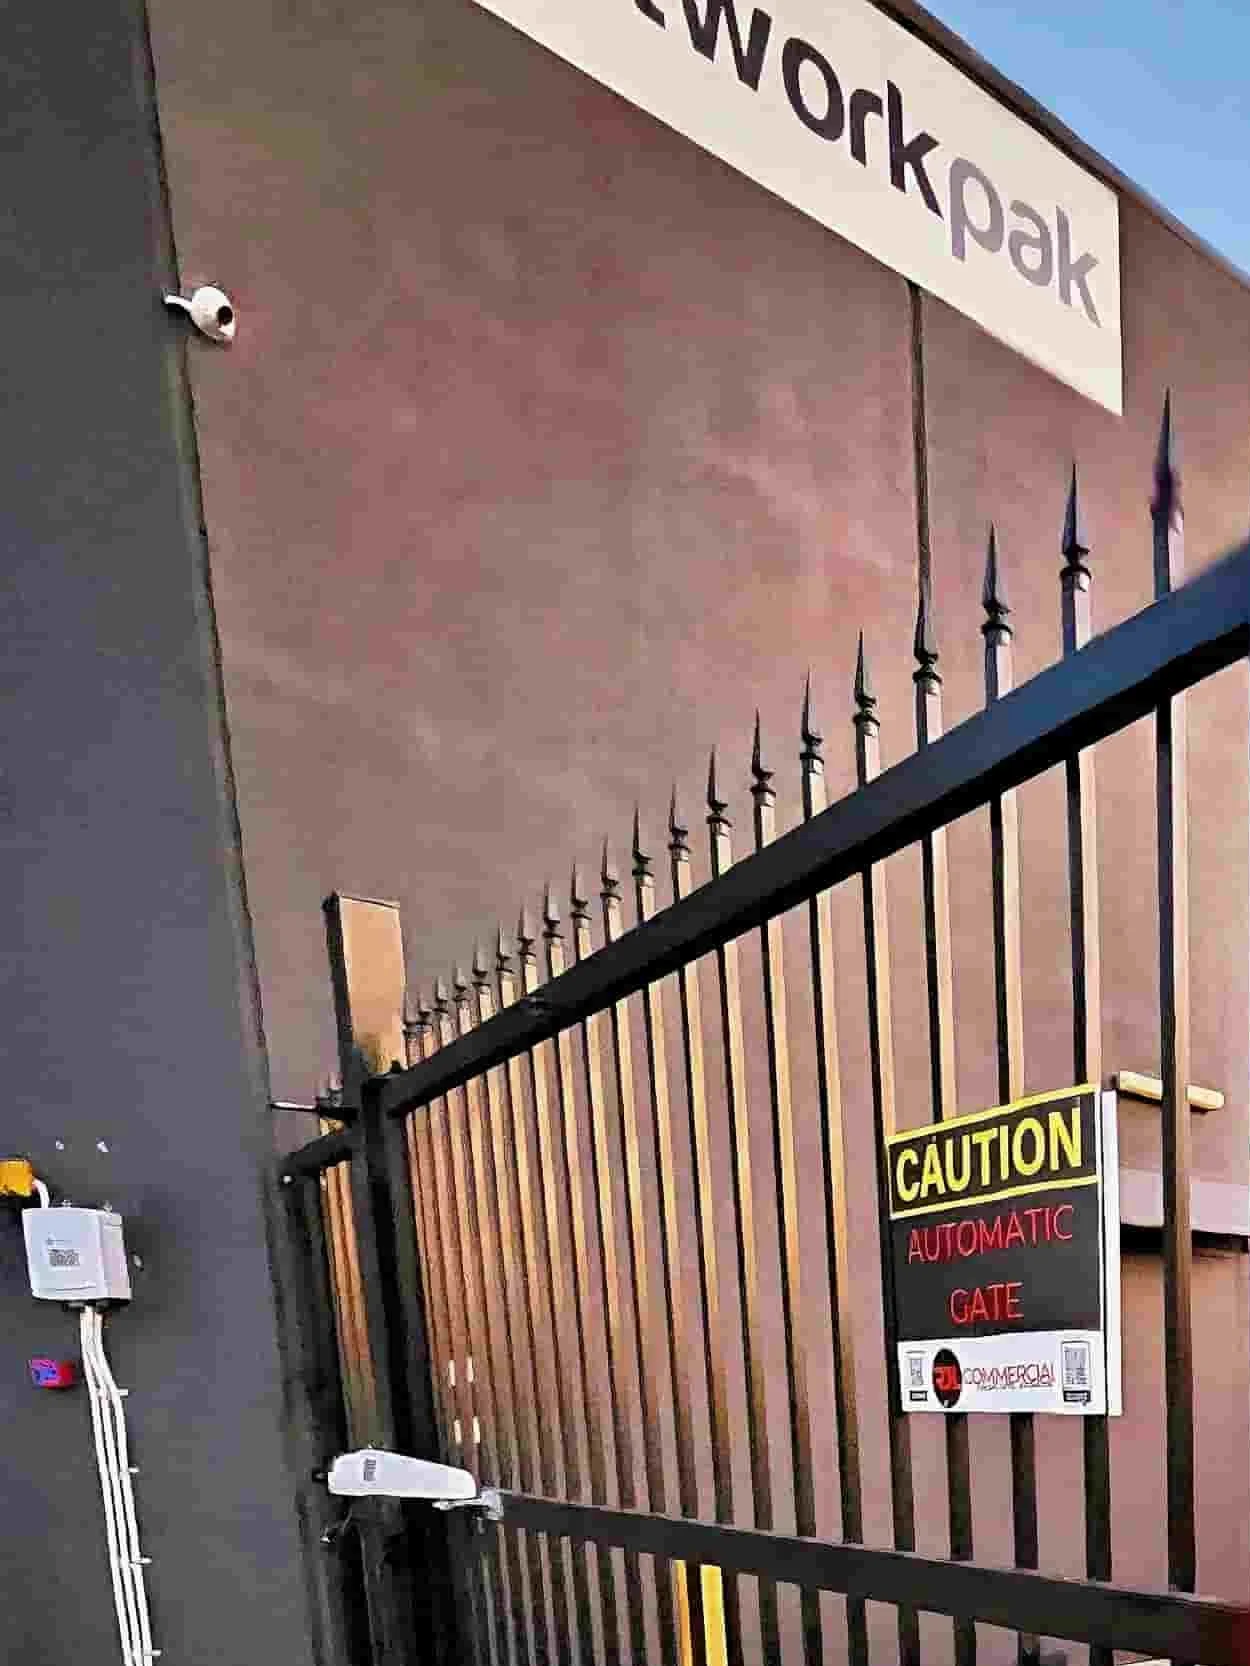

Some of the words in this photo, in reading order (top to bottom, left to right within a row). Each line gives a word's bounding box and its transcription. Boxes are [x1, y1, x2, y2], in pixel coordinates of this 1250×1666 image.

[896, 1107, 1082, 1203] CAUTION
[908, 1204, 1074, 1265] AUTOMATIC
[949, 1281, 1025, 1325] GATE
[963, 1362, 1056, 1386] COMMERCIAL
